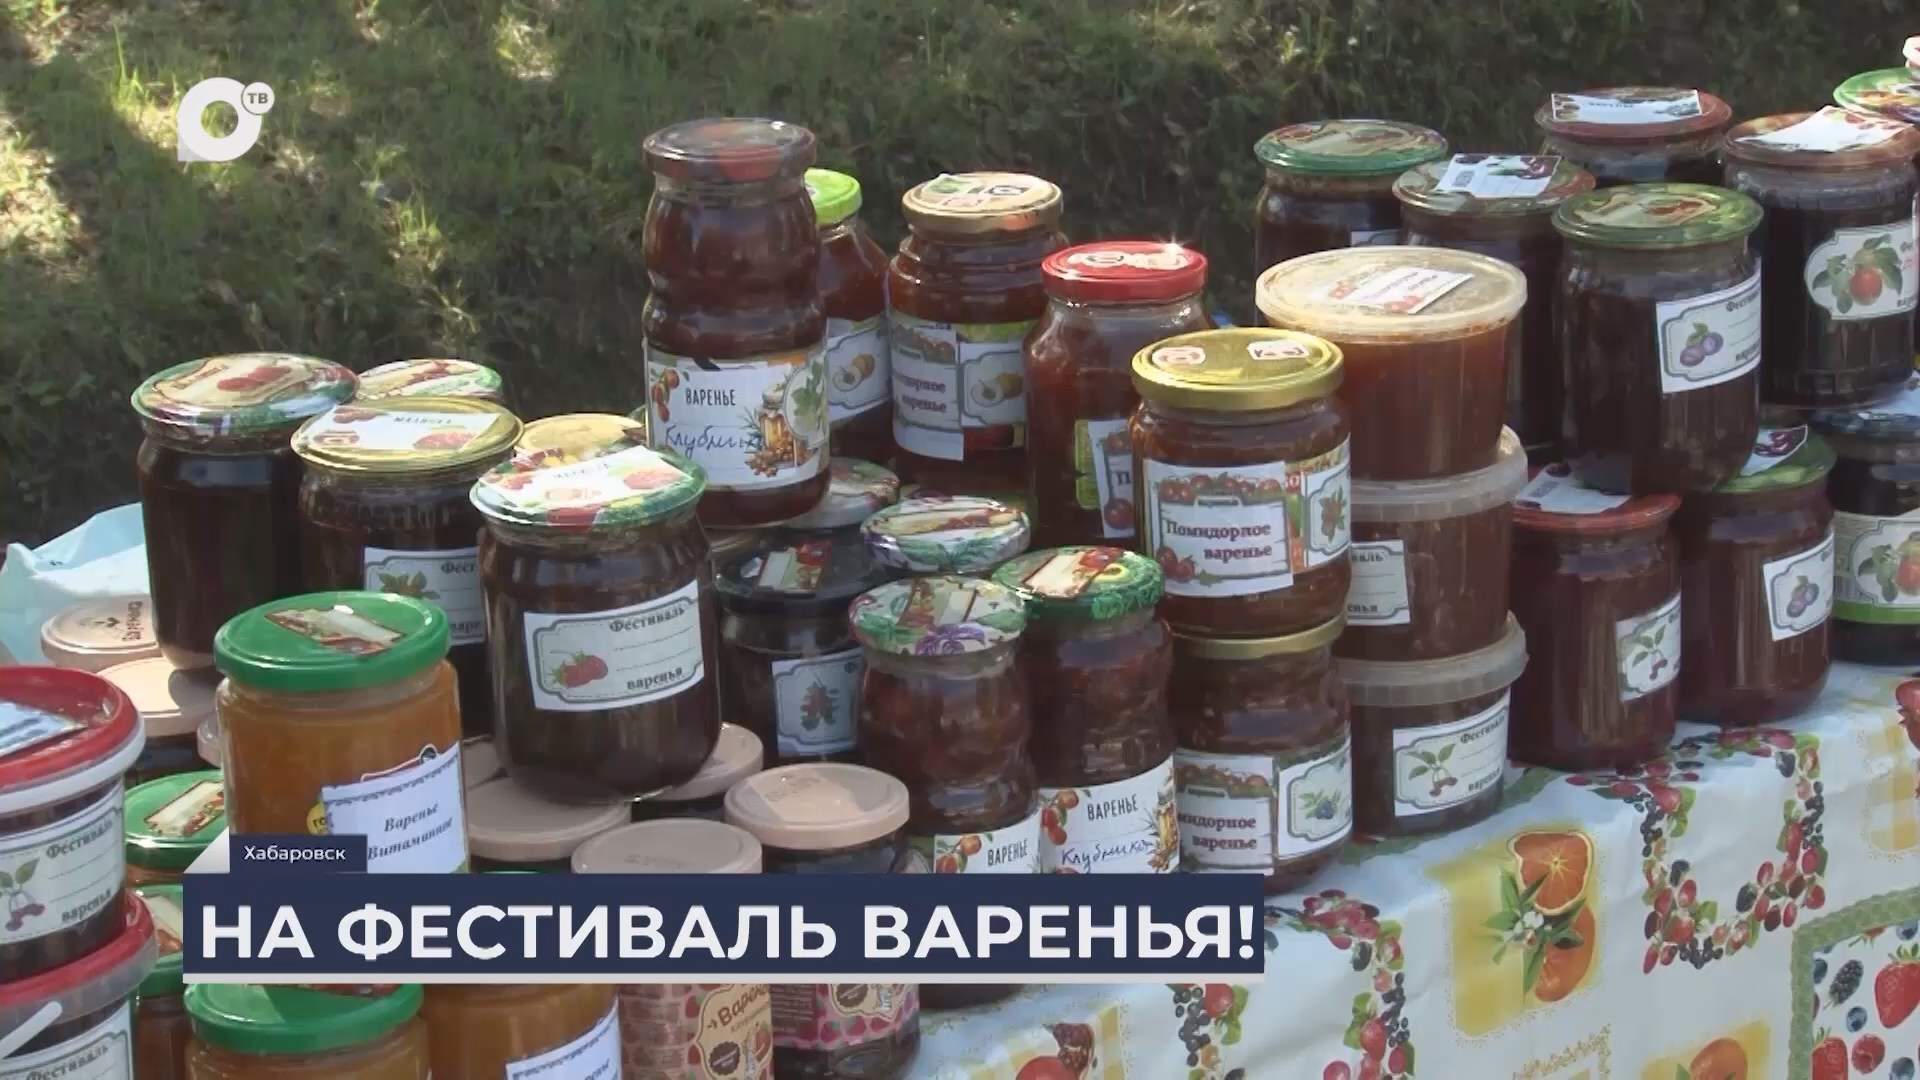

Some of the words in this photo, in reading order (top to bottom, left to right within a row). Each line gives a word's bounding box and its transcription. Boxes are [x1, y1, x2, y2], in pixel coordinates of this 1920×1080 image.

[685, 387, 736, 406] ВАРЕНЬЕ
[1166, 520, 1272, 541] Помидорное
[1203, 544, 1273, 564] варенье
[608, 605, 686, 632] Фестиваль
[626, 666, 684, 690] варенья
[1087, 793, 1139, 821] ВАРЕНЬЕ
[987, 838, 1029, 867] ВАРЕНЬЕ
[1191, 834, 1257, 851] варенье
